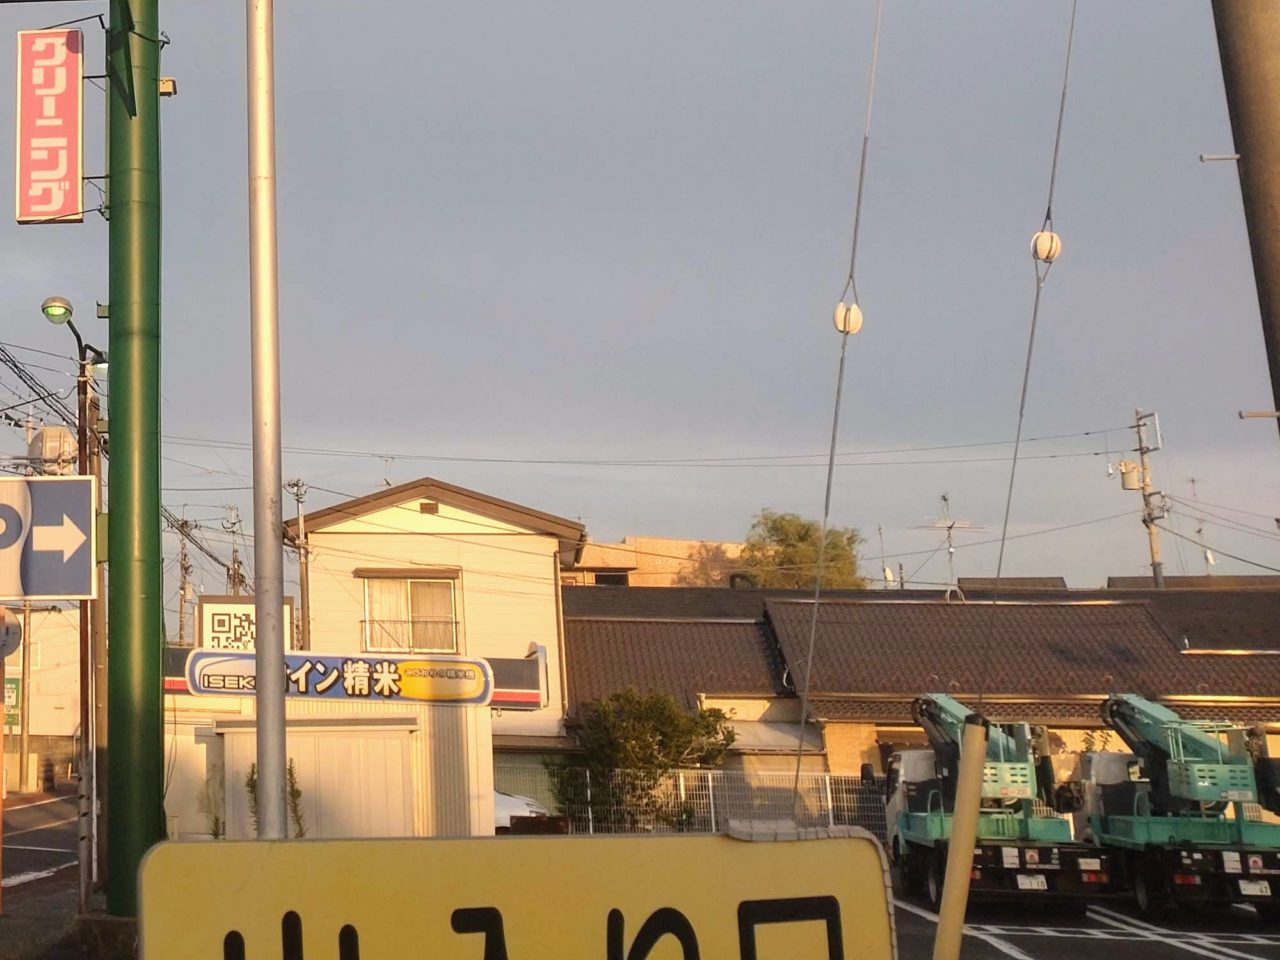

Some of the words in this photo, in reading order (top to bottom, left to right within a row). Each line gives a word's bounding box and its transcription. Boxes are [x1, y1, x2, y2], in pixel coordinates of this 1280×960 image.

[28, 37, 70, 212] クリーニング
[202, 673, 256, 690] ISEK
[284, 659, 402, 698] イン精米
